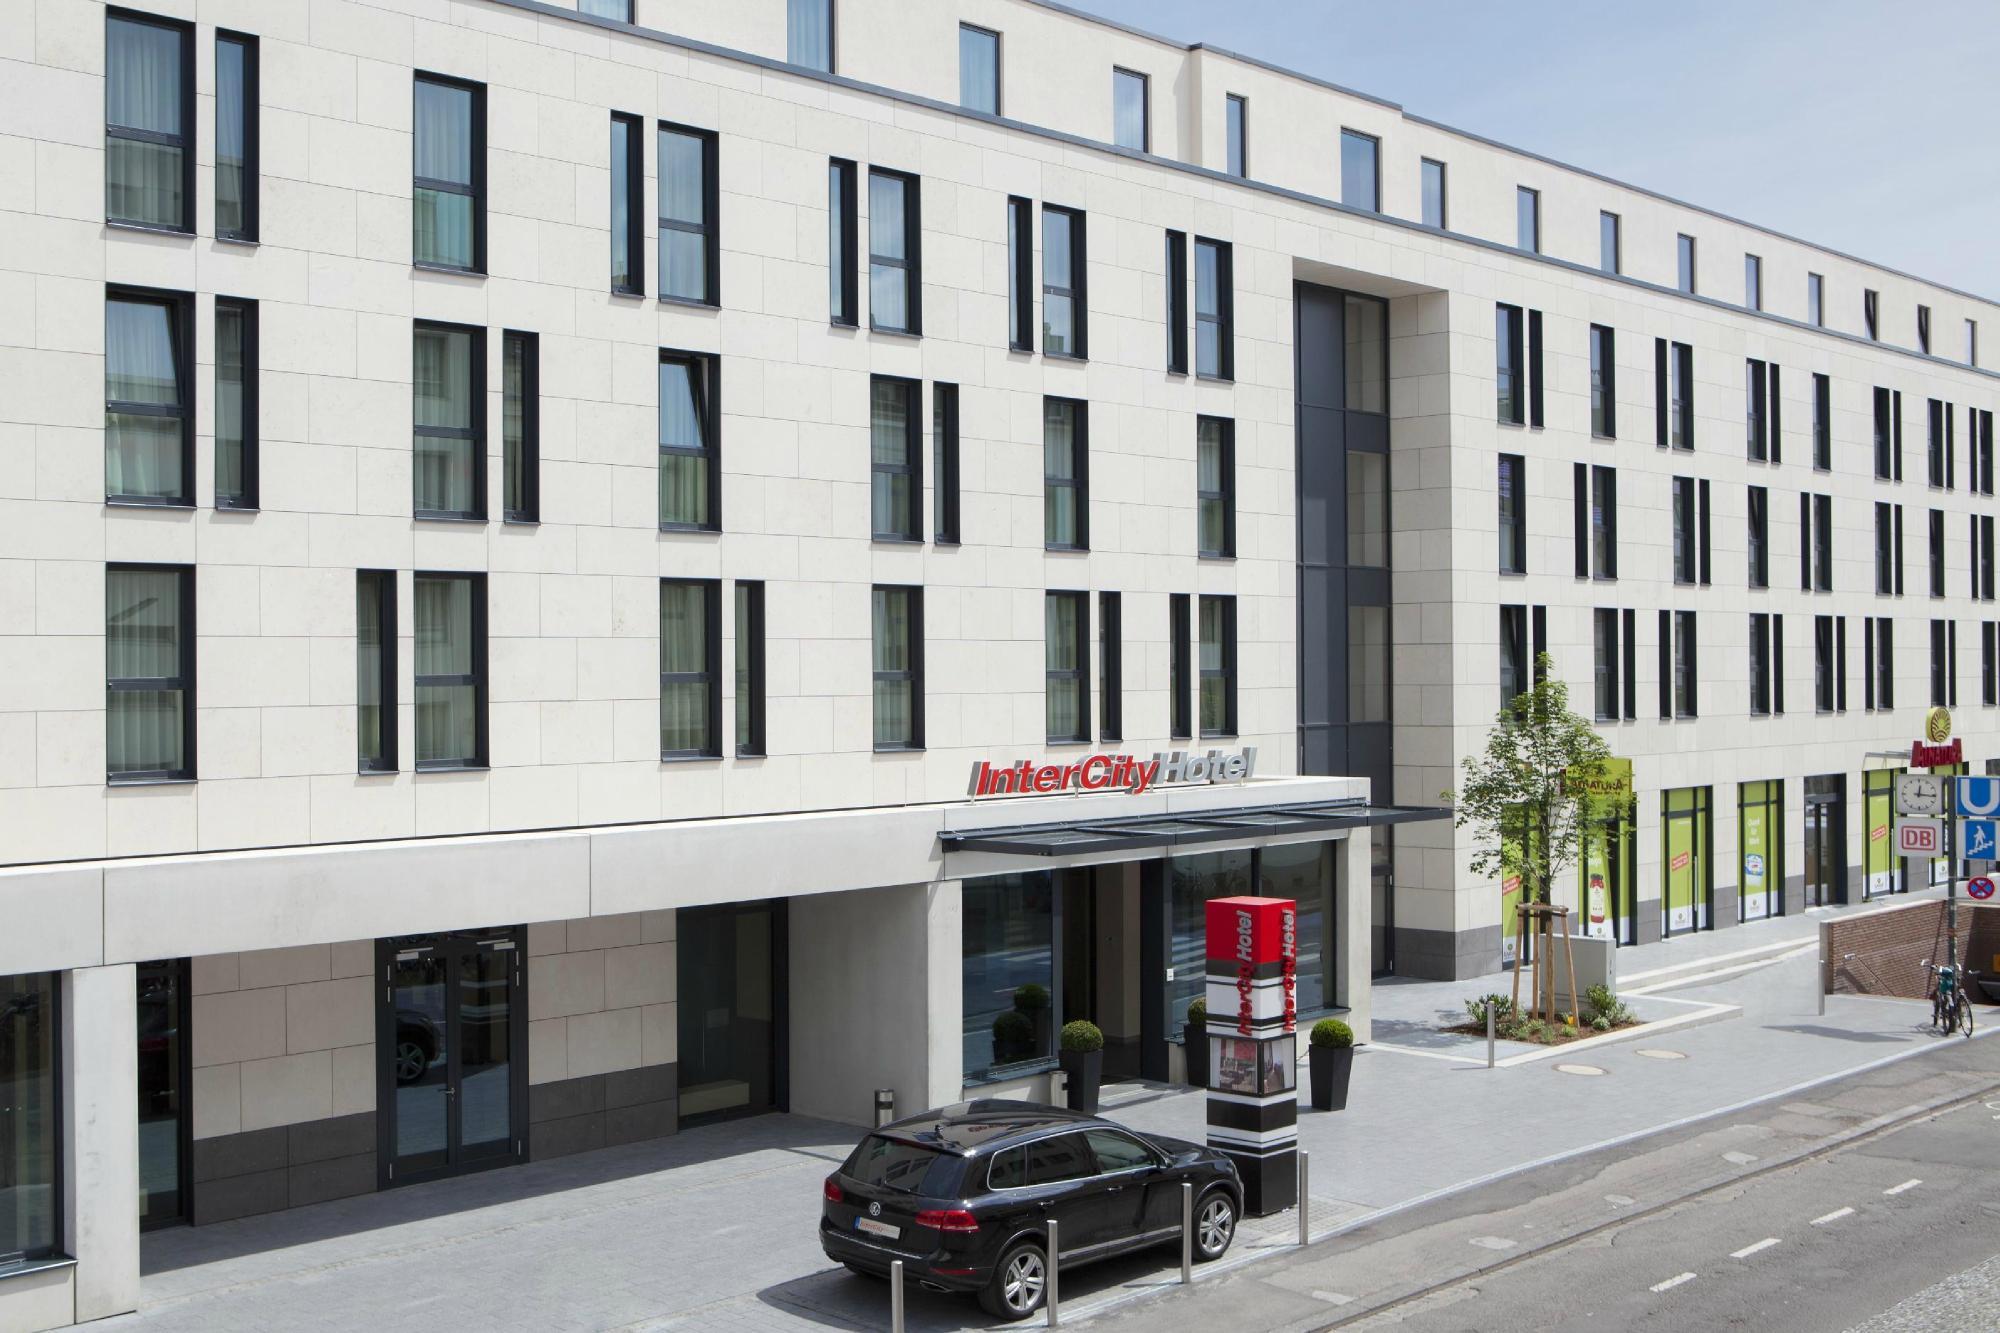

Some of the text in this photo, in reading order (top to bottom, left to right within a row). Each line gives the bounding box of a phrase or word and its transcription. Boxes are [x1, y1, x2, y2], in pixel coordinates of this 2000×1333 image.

[968, 746, 1258, 796] InterCityHotel
[1960, 778, 1999, 815] U
[1905, 829, 1932, 847] DB
[1235, 909, 1254, 1037] InterCityHotel
[1282, 908, 1297, 1033] InterCityHotel
